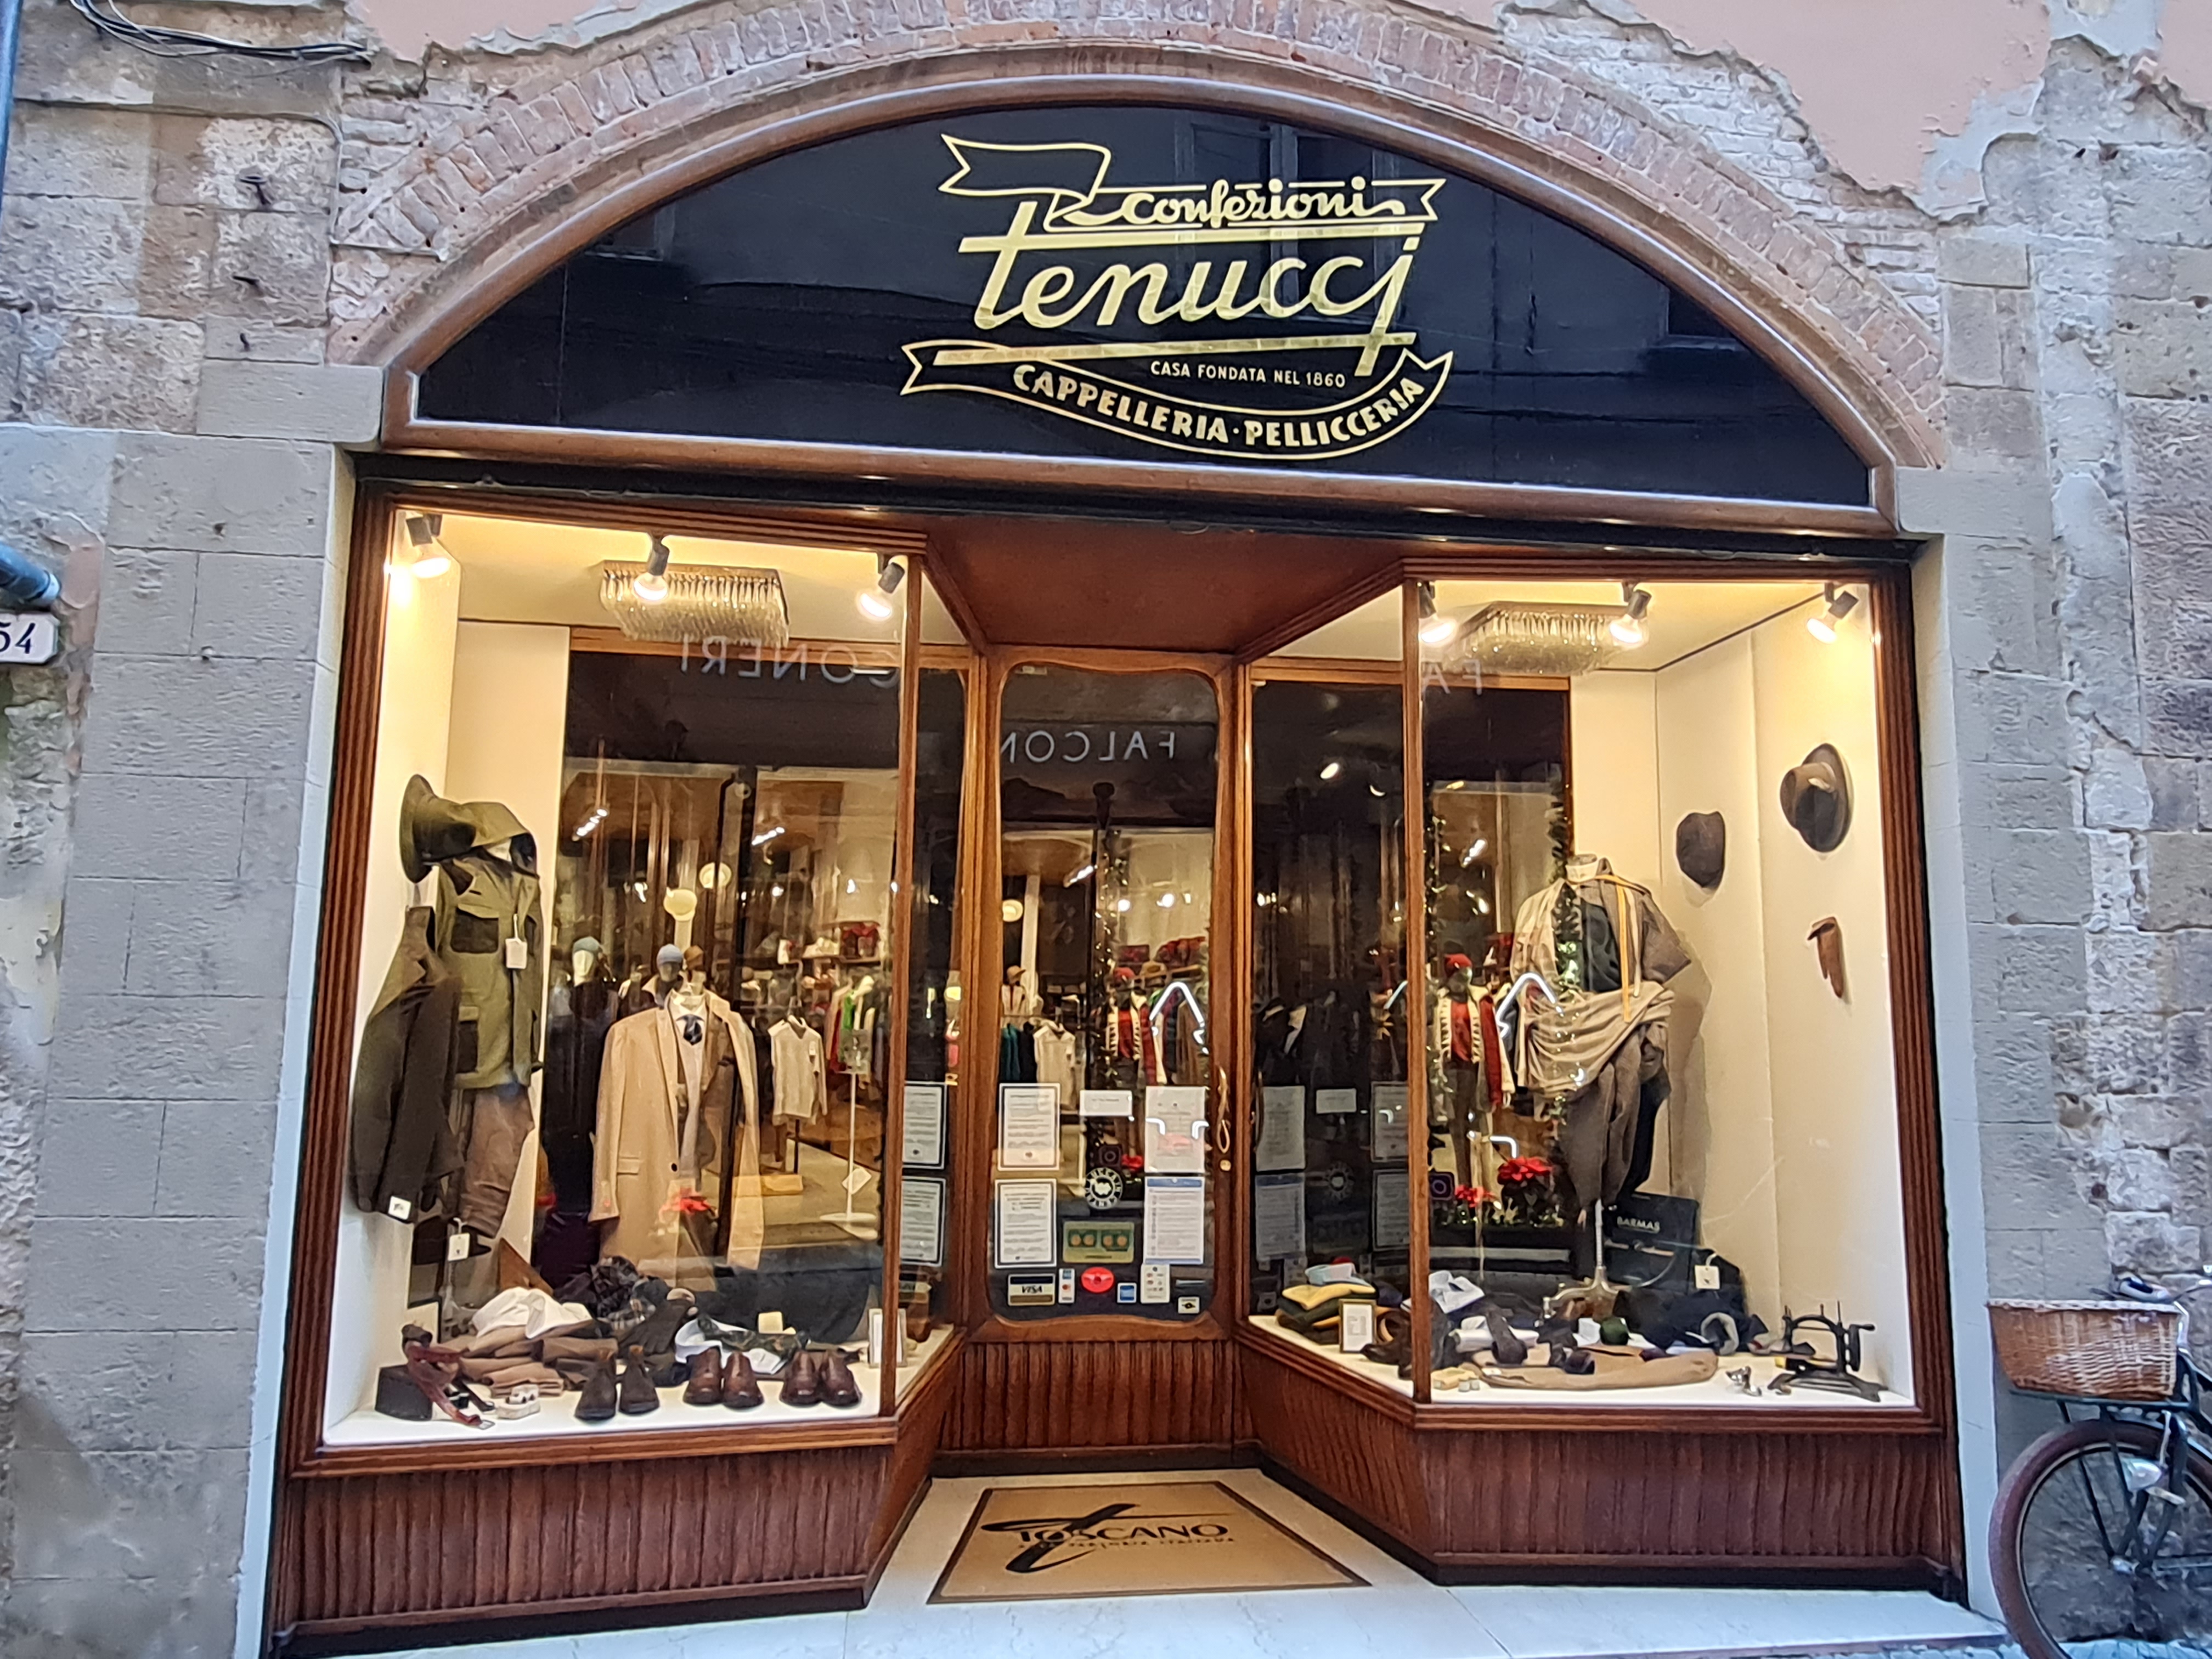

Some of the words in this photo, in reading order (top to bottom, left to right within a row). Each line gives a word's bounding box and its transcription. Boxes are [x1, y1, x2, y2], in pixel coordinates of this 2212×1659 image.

[1150, 360, 1191, 377] CASA
[1198, 364, 1266, 383] FONDATA
[1274, 370, 1300, 385] NEL
[1306, 371, 1346, 388] 1860
[1013, 364, 1228, 443] CAPPELLERIA
[1245, 376, 1425, 447] PELLICCERIA
[1022, 1285, 1043, 1294] VISA
[1019, 1523, 1229, 1543] TOSCANO
